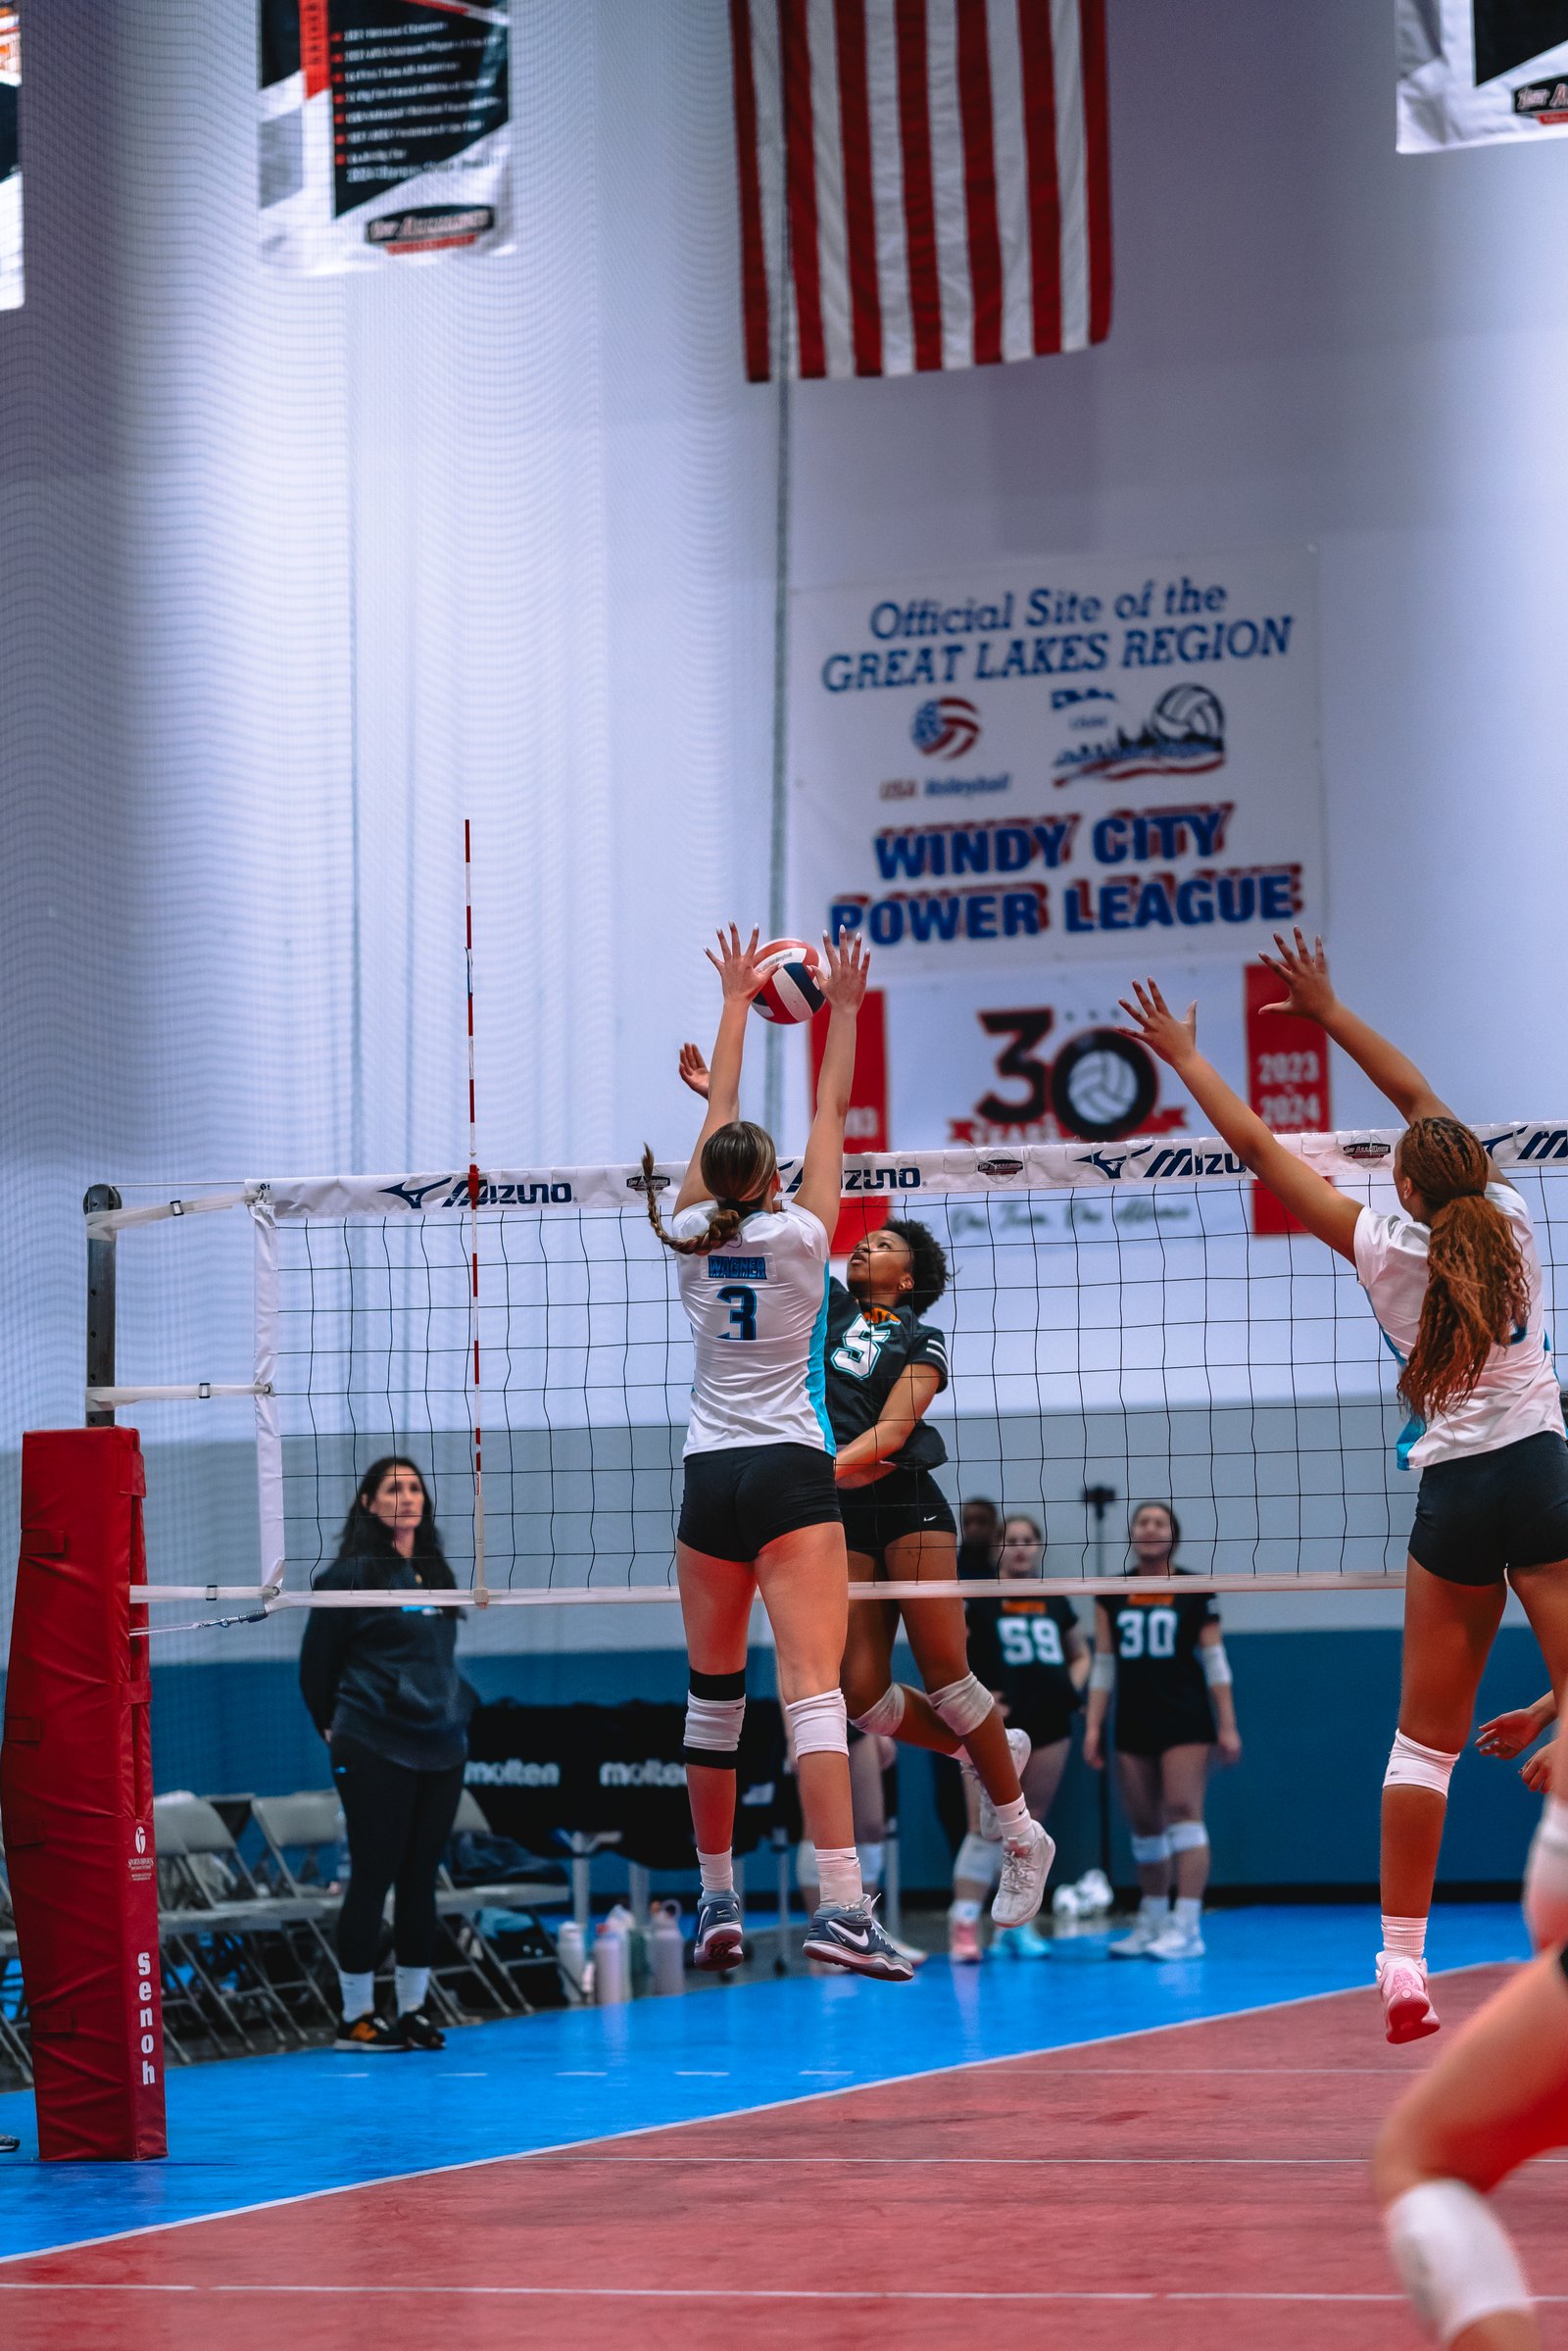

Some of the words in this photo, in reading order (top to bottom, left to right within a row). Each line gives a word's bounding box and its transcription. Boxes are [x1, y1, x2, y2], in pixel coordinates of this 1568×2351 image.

[870, 594, 1012, 640] Official
[1026, 588, 1102, 627] Site
[1114, 579, 1156, 621] of
[1163, 577, 1227, 616] the
[821, 645, 964, 692] GREAT
[975, 633, 1109, 678] LAKES
[1122, 615, 1294, 669] REGION
[873, 815, 1081, 881] WINDY
[1093, 803, 1235, 864] CITY
[830, 884, 1049, 949] POWER
[1064, 864, 1303, 934] LEAGUE
[977, 1006, 1160, 1144] 30
[1258, 1051, 1319, 1085] 2023
[1260, 1092, 1320, 1126] 2024
[716, 1285, 758, 1341] 3
[997, 1617, 1064, 1666] 59
[1117, 1609, 1178, 1659] 30
[464, 1760, 561, 1787] molten
[137, 1951, 156, 2085] senoh
